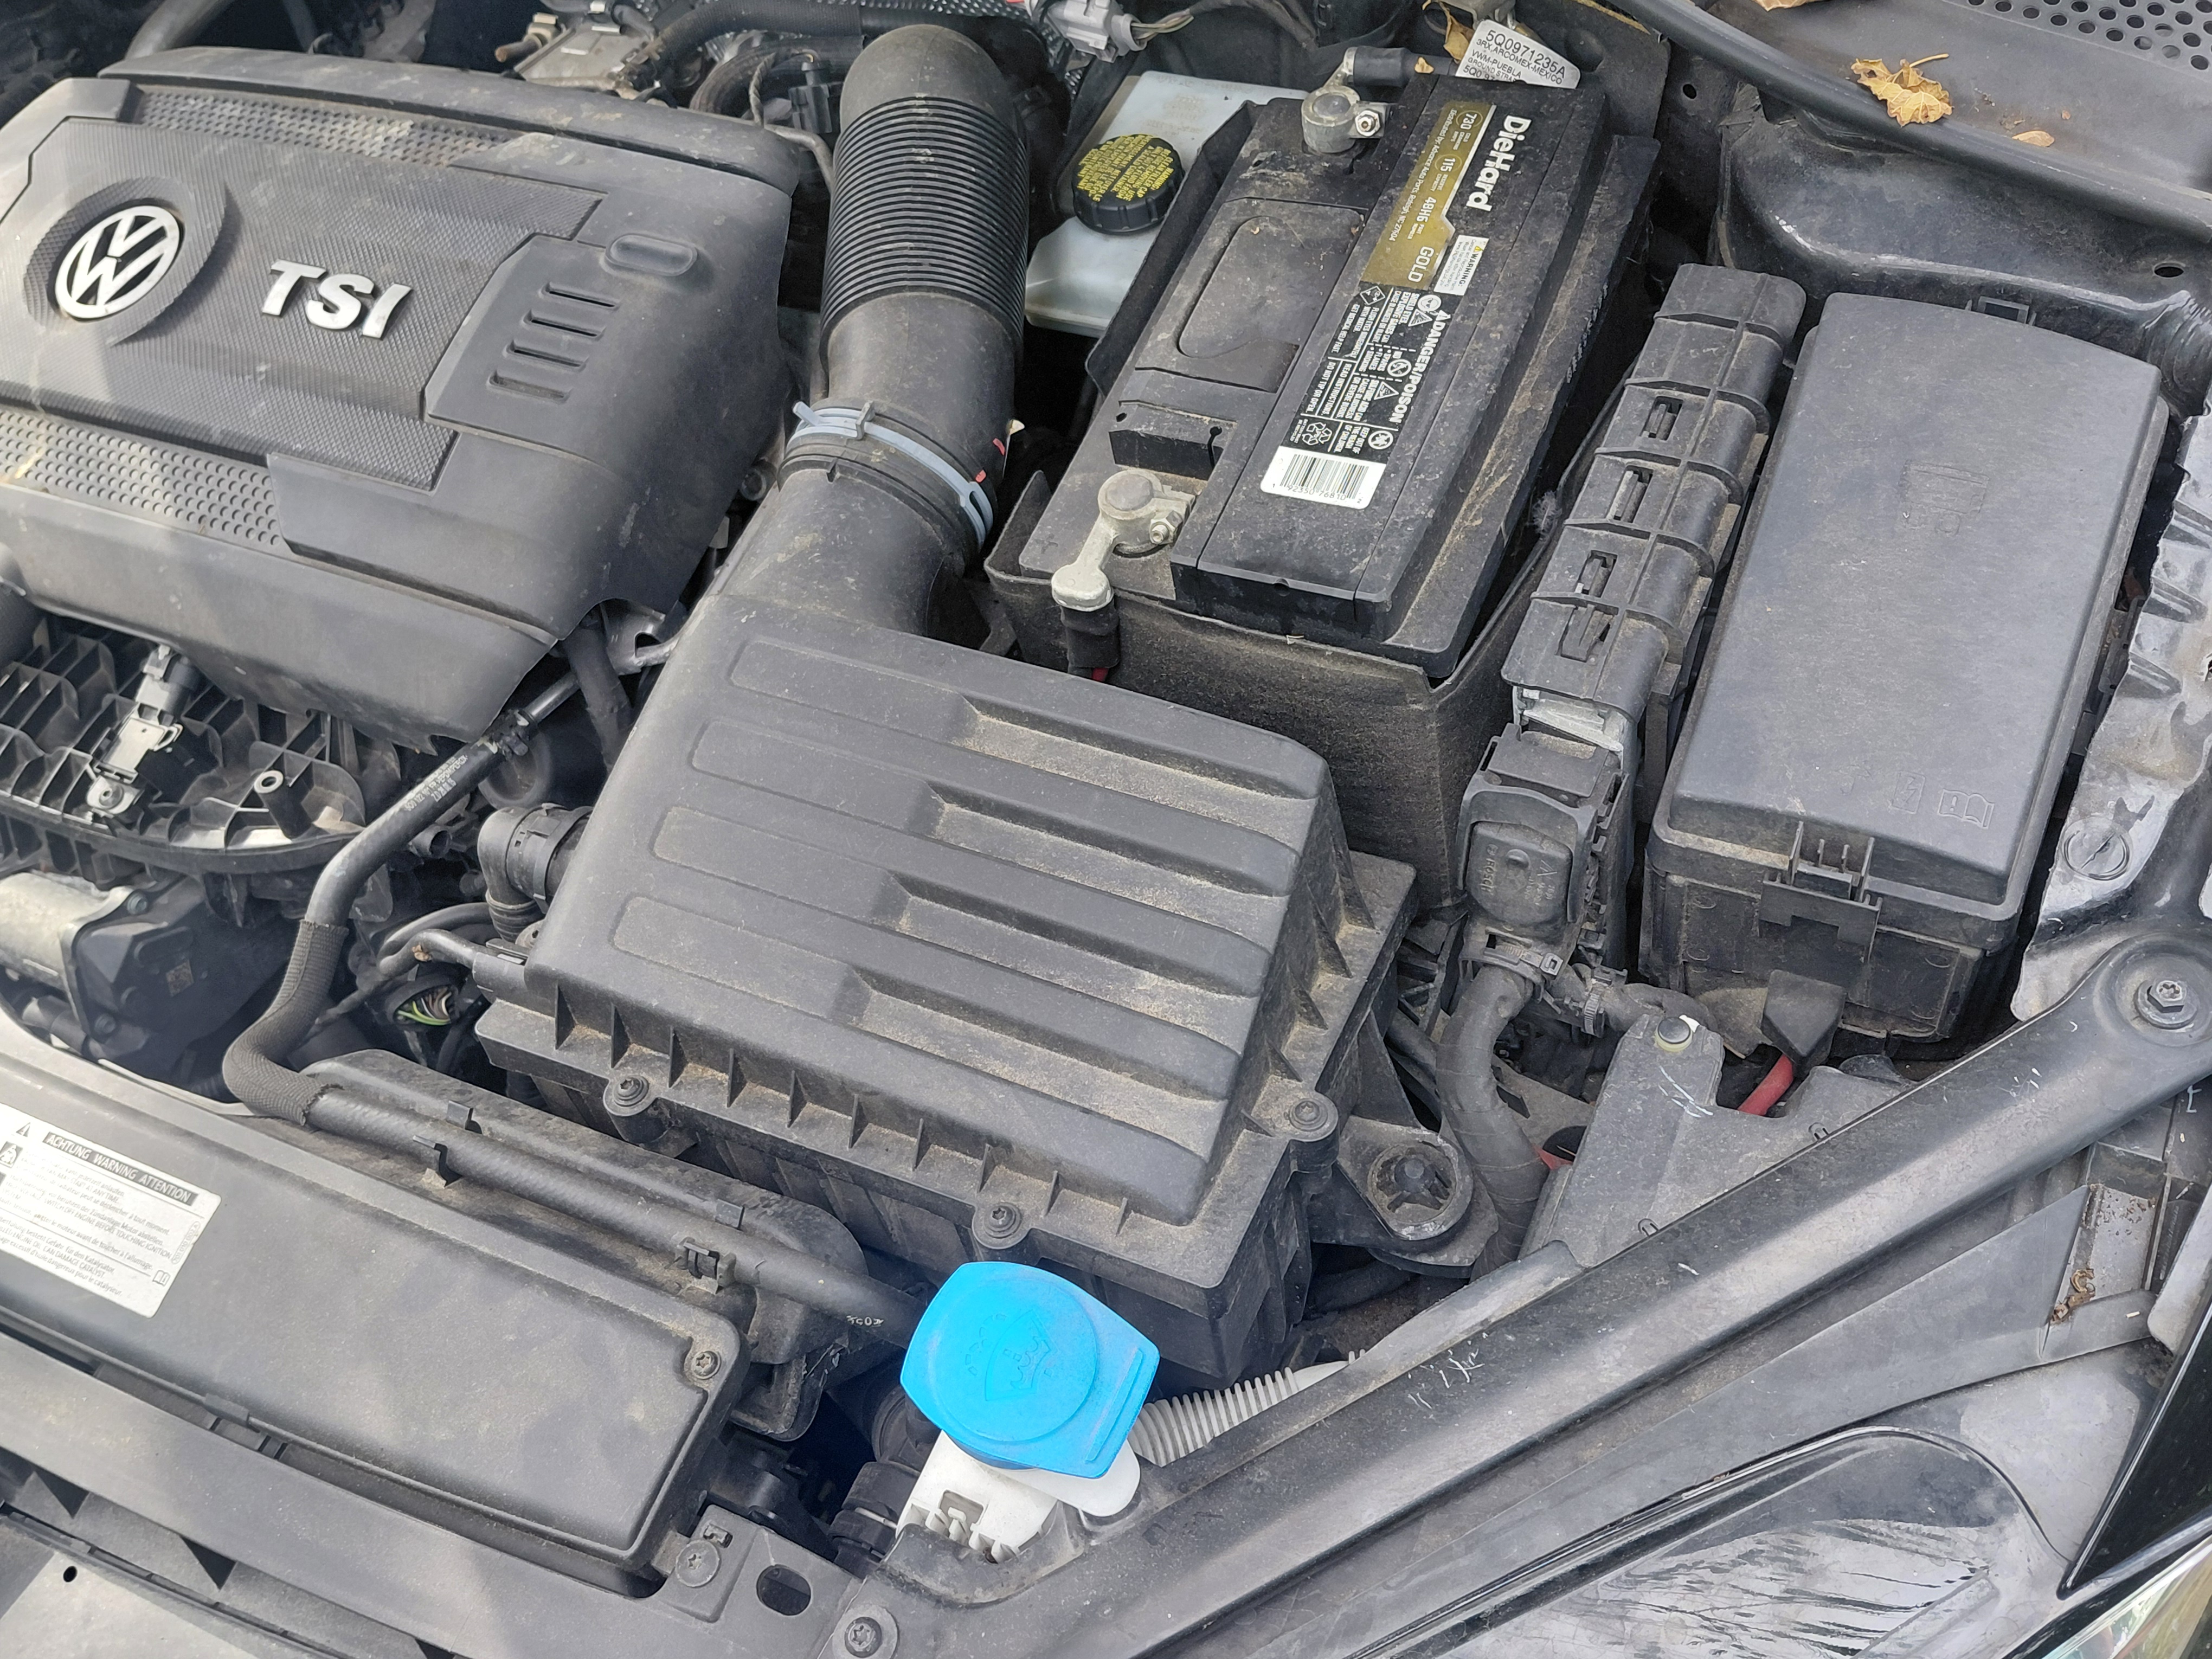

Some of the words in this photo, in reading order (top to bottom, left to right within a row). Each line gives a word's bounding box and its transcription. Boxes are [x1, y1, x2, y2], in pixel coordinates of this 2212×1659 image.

[1486, 30, 1566, 79] 5Q0971235A
[1463, 65, 1482, 78] 5Q0
[1468, 57, 1496, 75] GROUND
[1472, 49, 1521, 78] VWM-PUEBLA
[1458, 111, 1478, 130] 730
[1424, 144, 1440, 166] Advance
[1465, 115, 1529, 211] DieHard
[1157, 157, 1173, 172] CLEAN
[1418, 166, 1429, 179] Auto
[1438, 156, 1457, 173] 115
[1099, 169, 1121, 194] NETTOYER
[1128, 169, 1142, 184] FLUID
[1144, 170, 1161, 187] FILLER
[1116, 183, 1133, 199] FROM
[1123, 190, 1135, 202] USE
[1137, 187, 1148, 198] CAP
[55, 205, 182, 320] VW
[1407, 246, 1435, 282] GOLD
[262, 260, 412, 339] TSI
[1386, 291, 1417, 318] EXPLOSIVE
[1401, 292, 1423, 311] SHIELD
[1338, 312, 1359, 330] MEDICAL
[1365, 307, 1382, 320] FLUSH
[1360, 320, 1374, 331] EYES
[1381, 318, 1401, 335] GASES
[1334, 330, 1349, 342] HELP
[1358, 350, 1374, 372] SMOKING
[1368, 352, 1382, 370] FLAMES
[1377, 353, 1391, 371] SPARKS
[1320, 370, 1333, 380] NOT
[1339, 363, 1352, 378] READ
[1388, 320, 1446, 423] DANGER/POISON
[1311, 389, 1323, 397] OR
[1315, 380, 1328, 389] TIP
[1343, 384, 1358, 402] SEVERE
[1357, 378, 1369, 393] CAUSE
[1288, 485, 1315, 495] 92350
[1319, 491, 1346, 500] 76810
[44, 1133, 94, 1160] ACHTUNG
[91, 1152, 139, 1180] WARNING
[136, 1172, 192, 1204] ATTENTION
[120, 1221, 139, 1235] Motor
[133, 1215, 146, 1225] tout
[74, 1211, 97, 1225] ENGINE
[94, 1219, 116, 1234] BEFORE
[115, 1229, 146, 1248] TOUCHING
[144, 1241, 172, 1259] IGNITION
[42, 1245, 56, 1256] CAN
[54, 1250, 80, 1266] DAMAGE
[73, 1249, 86, 1259] den
